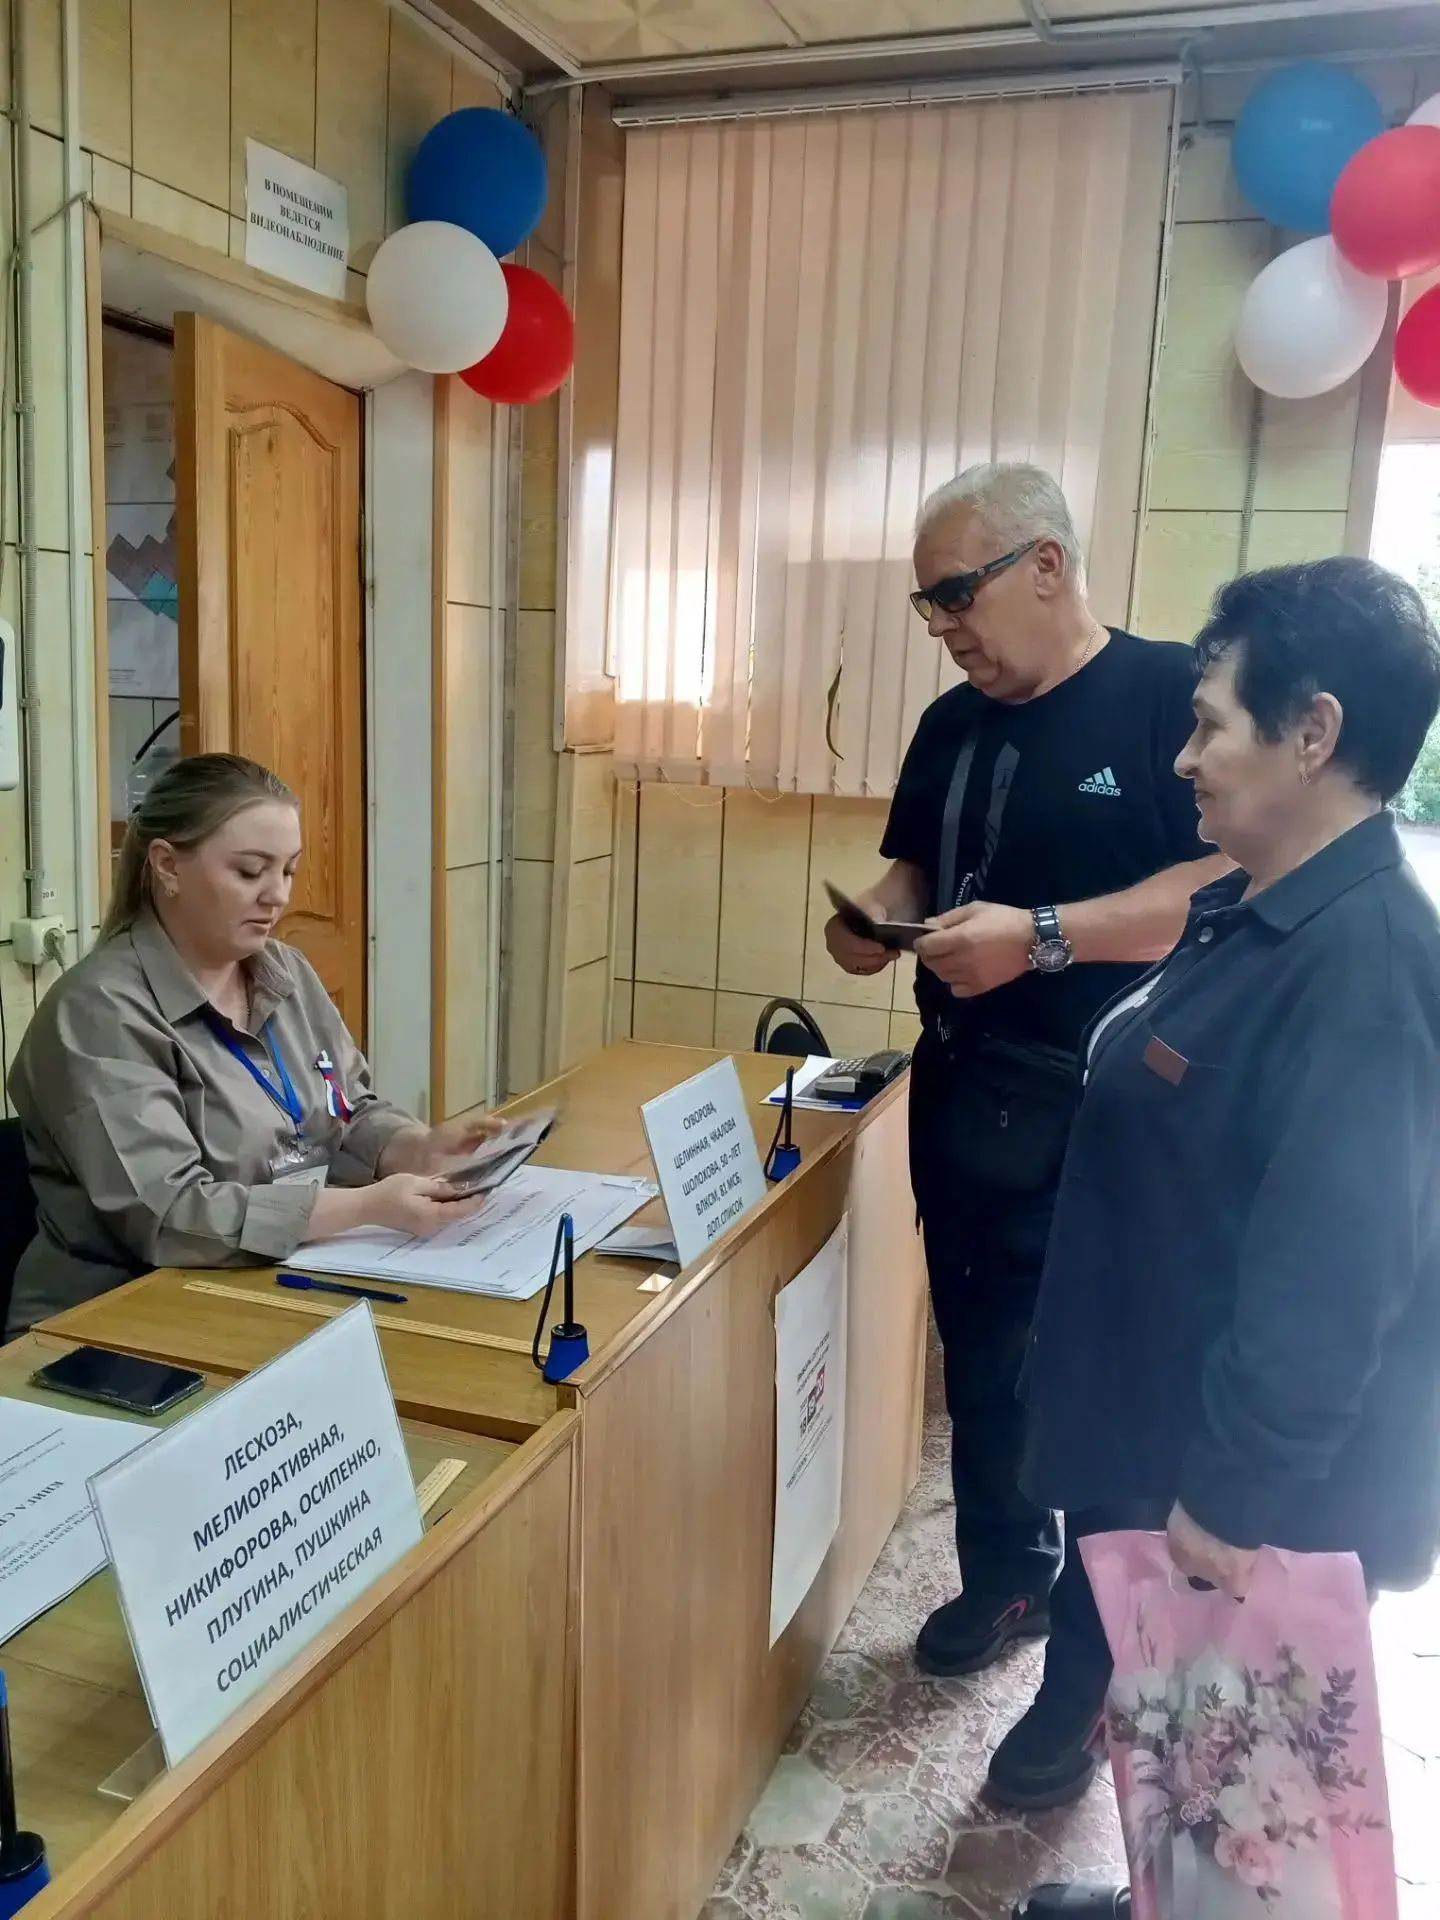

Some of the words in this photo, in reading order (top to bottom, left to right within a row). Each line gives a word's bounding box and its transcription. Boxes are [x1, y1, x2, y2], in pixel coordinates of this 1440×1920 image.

[265, 179, 270, 190] В
[273, 182, 332, 219] ПОМЕЩЕНИИ
[280, 205, 320, 232] ВЕДЕТСЯ
[251, 213, 343, 261] ВИДЕОНАБЛЮДЕНИЕ
[1078, 782, 1121, 797] adidas
[682, 1160, 721, 1196] ШОЛОХОВА,
[719, 1182, 728, 1197] 81
[721, 1197, 743, 1224] СПИСОК
[225, 1412, 302, 1480] ЛЕСХОЗА,
[193, 1424, 344, 1552] МЕЛИОРАТИВНАЯ,
[165, 1513, 297, 1626] НИКИФОРОВА,
[300, 1439, 380, 1514] ОСИПЕНКО,
[207, 1565, 293, 1644] ПЛУГИНА,
[295, 1490, 370, 1566] ПУШКИНА
[217, 1527, 382, 1691] СОЦИАЛИСТИЧЕСКАЯ
